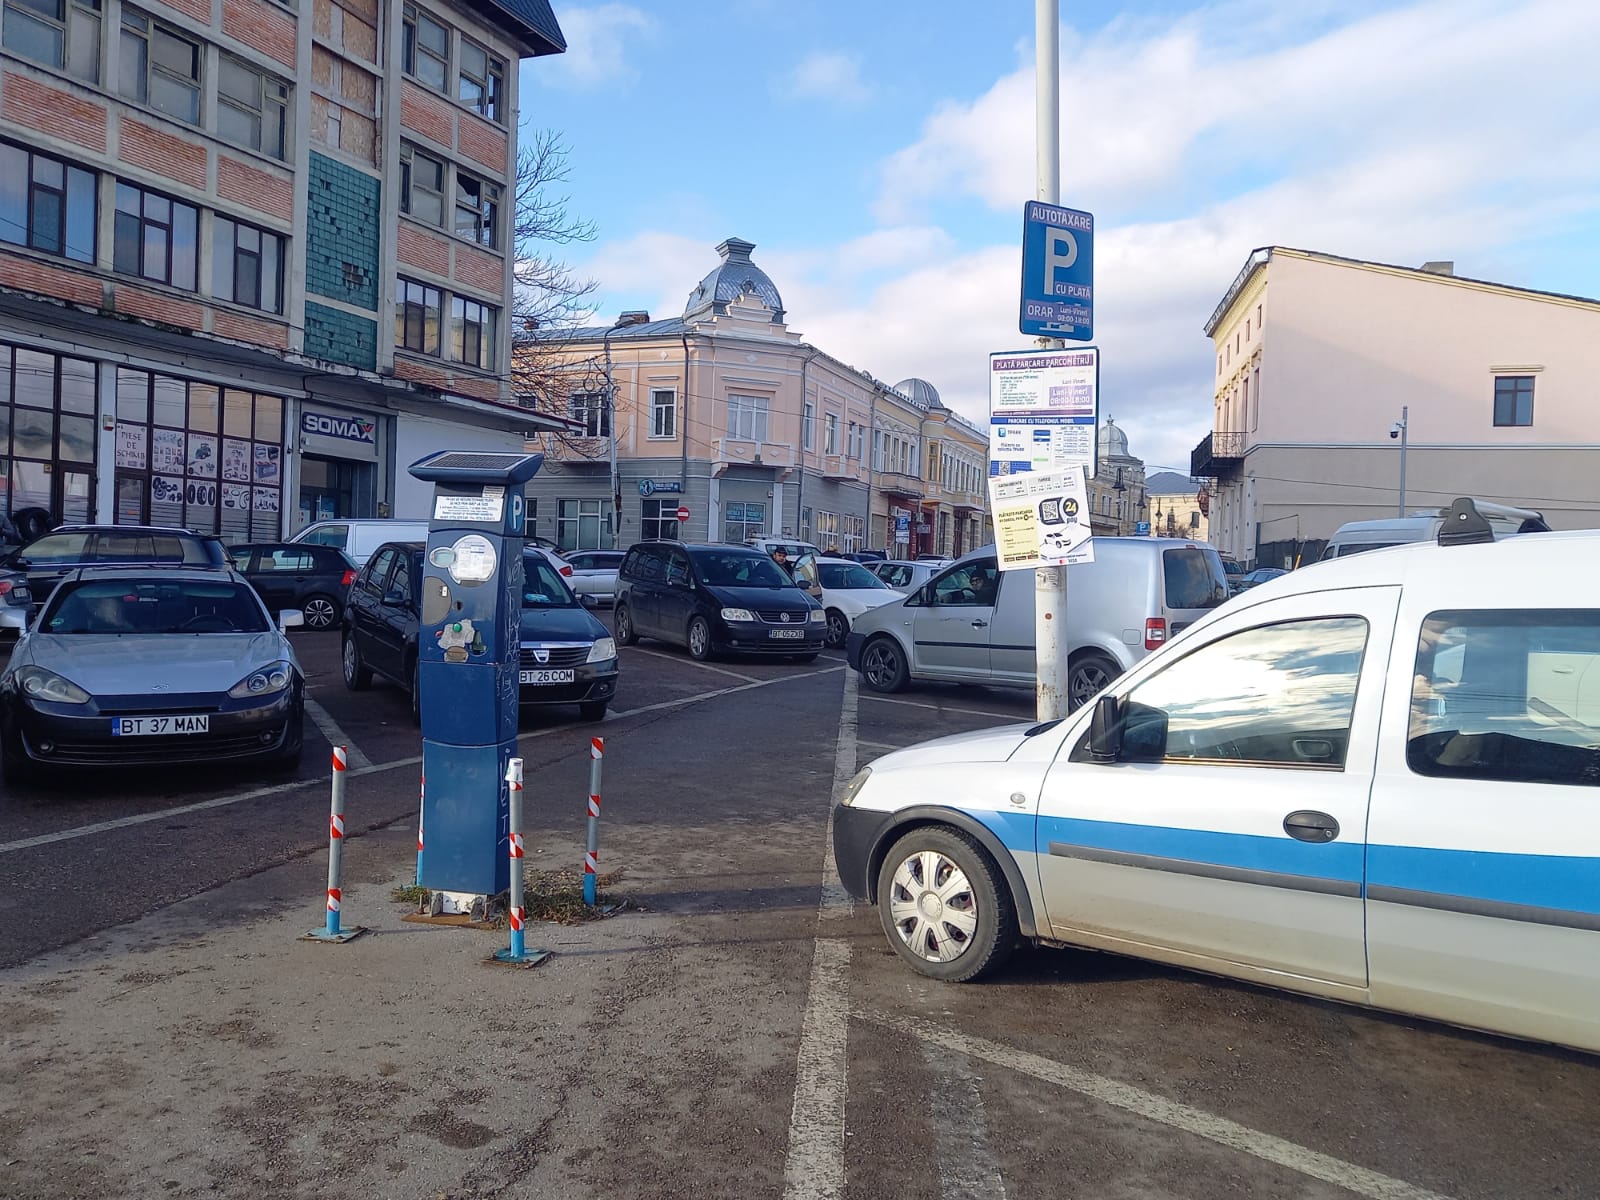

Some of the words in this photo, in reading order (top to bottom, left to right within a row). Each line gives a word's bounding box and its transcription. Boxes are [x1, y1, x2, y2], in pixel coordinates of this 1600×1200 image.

[1032, 207, 1091, 230] AUTOTAXARE
[1044, 226, 1078, 295] P
[1056, 284, 1066, 294] CU
[1027, 305, 1053, 318] ORAR
[1016, 359, 1045, 368] PARCARE
[1046, 356, 1090, 367] PARCOMETRU
[305, 415, 375, 441] SOMAX
[121, 431, 142, 441] PIESE
[127, 441, 136, 450] DE
[512, 495, 522, 529] P
[1065, 501, 1077, 513] 24
[1139, 523, 1146, 532] P
[520, 671, 534, 682] BT
[537, 671, 550, 682] 26
[551, 671, 573, 681] COM
[122, 719, 143, 734] BT
[150, 718, 169, 733] 37
[174, 716, 207, 731] MAN
